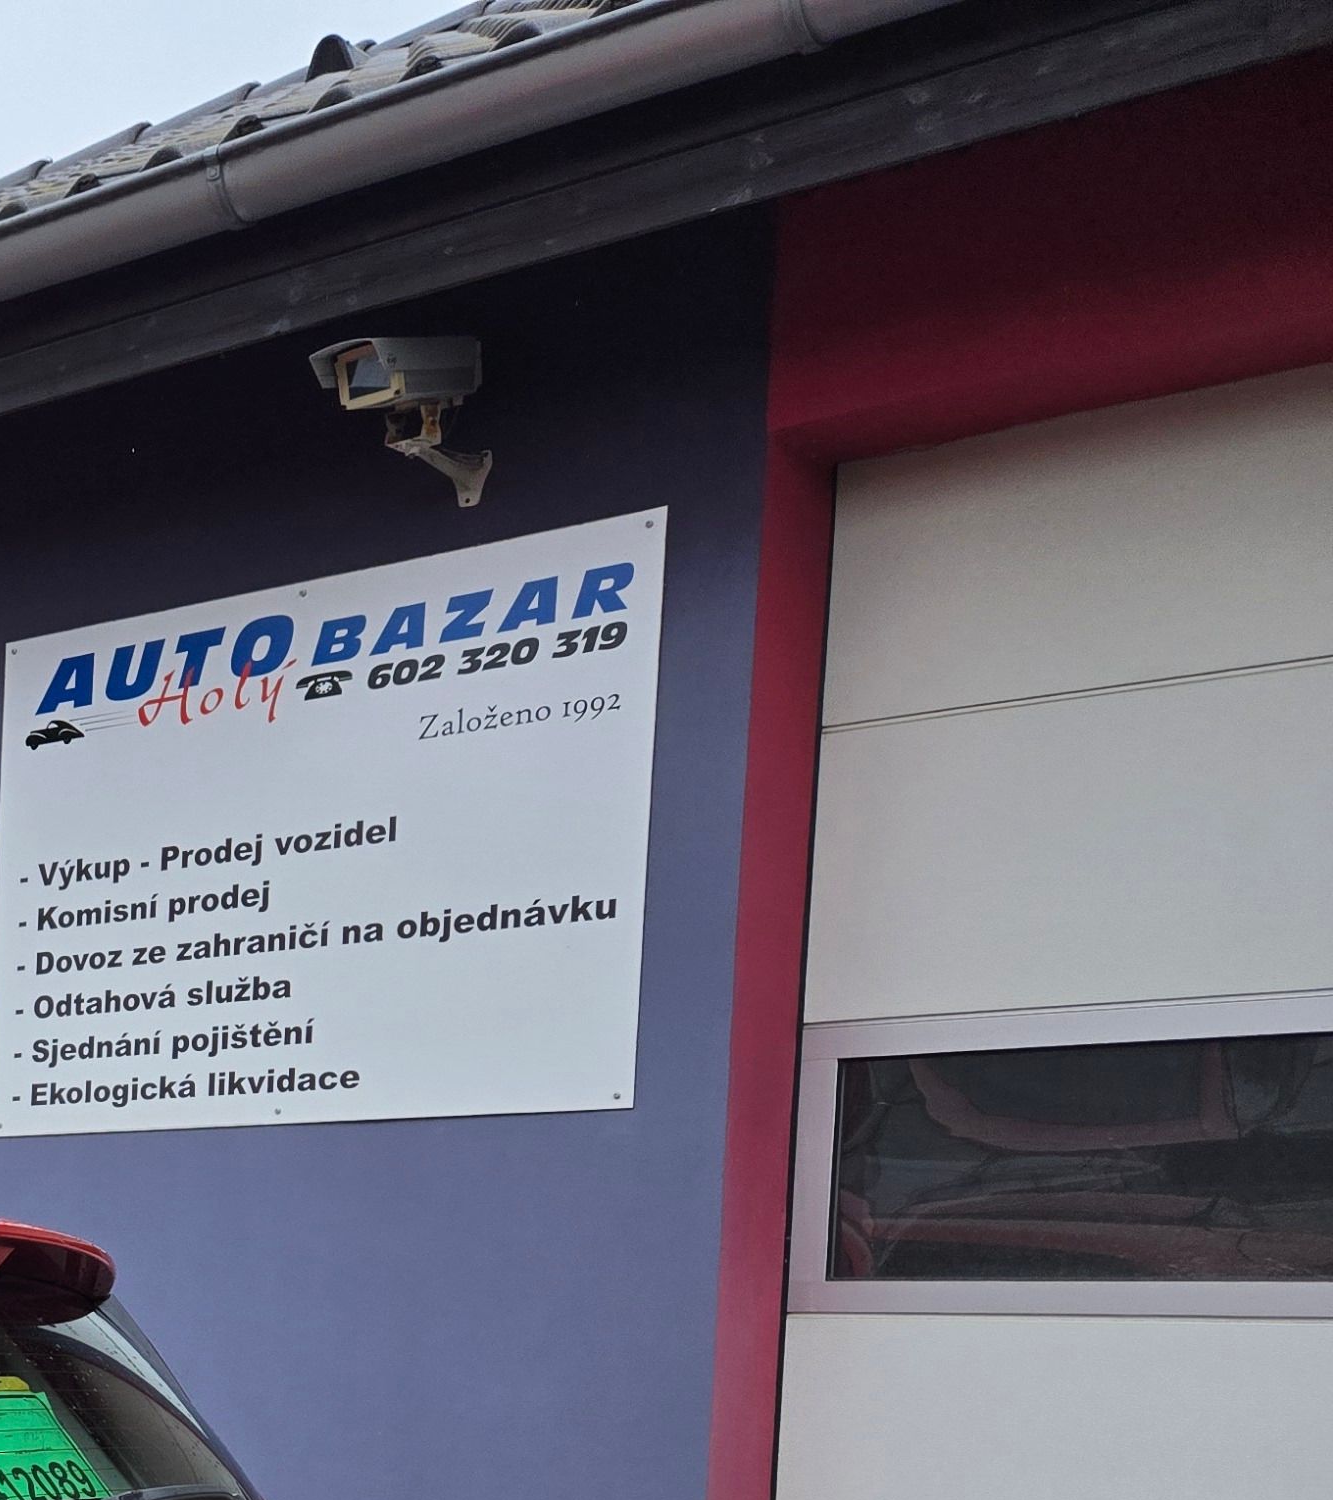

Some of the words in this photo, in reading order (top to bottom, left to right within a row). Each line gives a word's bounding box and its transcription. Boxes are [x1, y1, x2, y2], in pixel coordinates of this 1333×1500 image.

[35, 615, 294, 716] AUTO
[311, 563, 635, 667] BAZAR
[367, 654, 446, 690] 602
[456, 637, 540, 676] 320
[551, 621, 628, 659] 319
[137, 659, 297, 727] Holý
[418, 704, 552, 740] Založeno
[562, 693, 621, 723] 1992
[38, 858, 131, 891] Výkup
[160, 833, 263, 872] Prodej
[274, 815, 397, 856] vozidel
[35, 949, 123, 976] Dovoz
[131, 945, 166, 966] ze
[176, 920, 330, 962] zahraničí
[342, 922, 384, 945] na
[396, 894, 617, 943] objednávku
[37, 893, 158, 932] Komisní
[168, 880, 270, 923] prodej
[33, 983, 176, 1019] Odtahová
[186, 975, 291, 1007] služba
[31, 1030, 161, 1069] Sjednání
[171, 1018, 314, 1060] pojištění
[30, 1073, 196, 1108] Ekologická
[208, 1067, 360, 1097] likvidace
